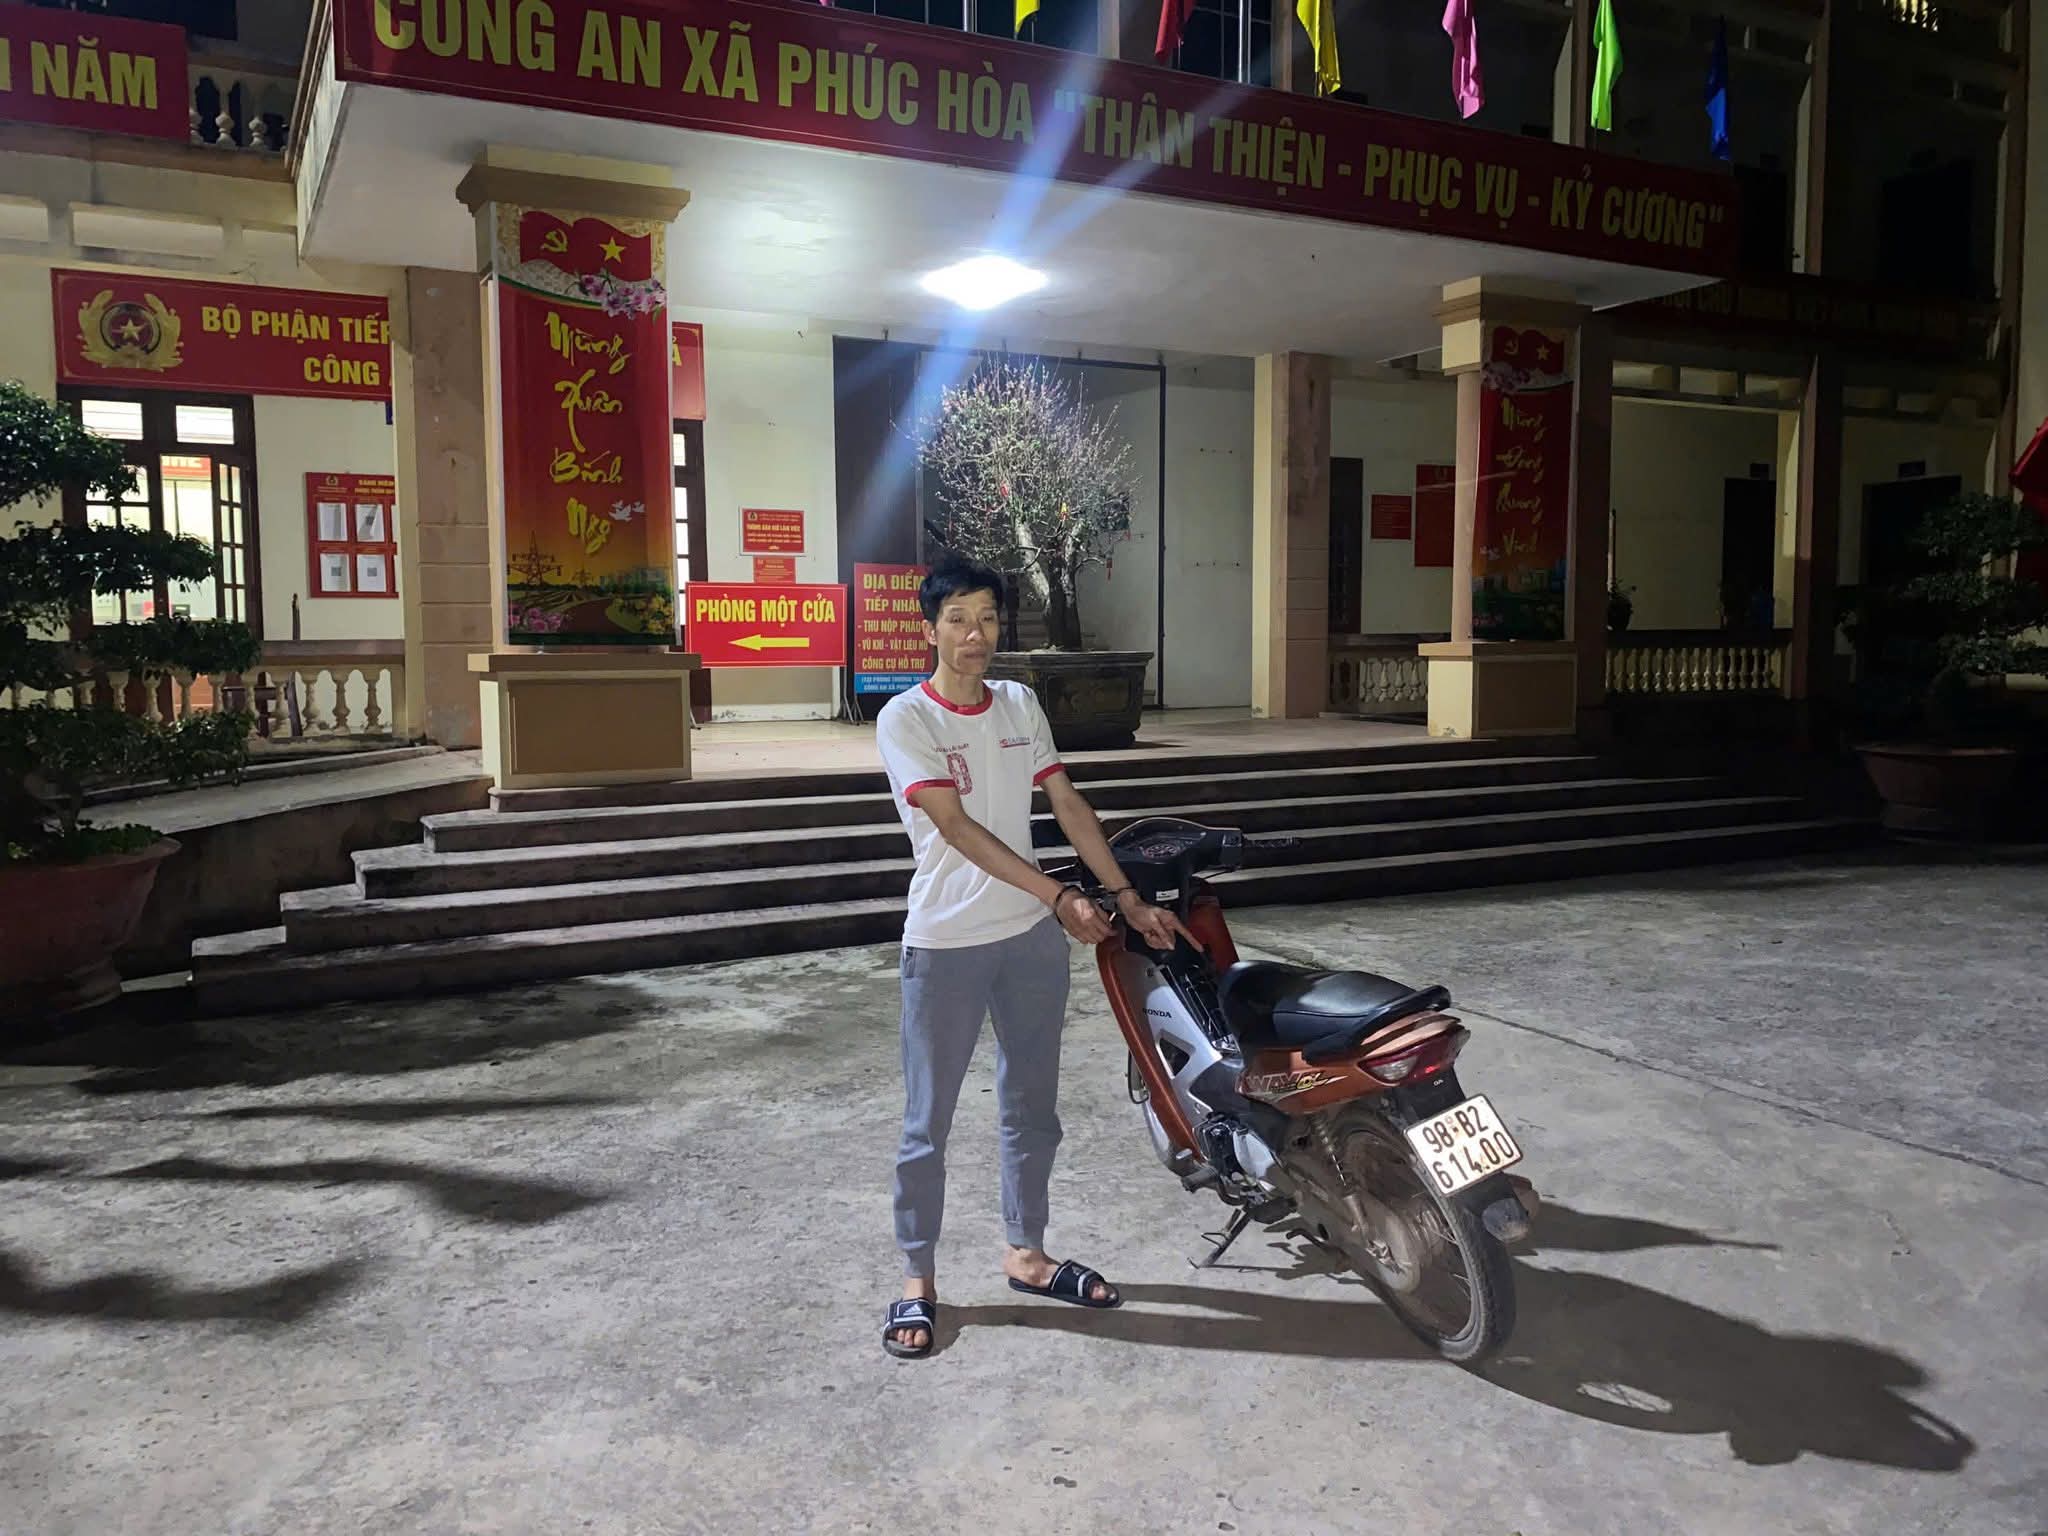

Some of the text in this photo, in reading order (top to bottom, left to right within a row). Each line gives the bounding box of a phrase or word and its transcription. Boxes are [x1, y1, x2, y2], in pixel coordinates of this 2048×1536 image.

[31, 35, 157, 109] NĂM
[577, 9, 661, 88] AN
[682, 21, 759, 102] XÃ
[778, 43, 919, 126] PHÚC
[937, 61, 1034, 144] HÒA
[1209, 117, 1325, 196] THIỆN
[1364, 143, 1462, 216] PHỤC
[1475, 160, 1518, 228] VỤ
[1551, 163, 1593, 230] KỶ
[202, 303, 241, 339] BỘ
[251, 308, 330, 344] PHẬN
[544, 311, 632, 374] Mừng
[304, 353, 380, 386] CÔNG
[554, 368, 623, 453] Xuân
[550, 447, 622, 483] Bính
[863, 573, 887, 593] ĐỊA
[696, 592, 836, 627] PHÒNG MỘT CỬA
[864, 594, 889, 612] TIẾP
[864, 619, 879, 632] THU
[880, 617, 897, 635] NỘP
[862, 656, 884, 670] CÔNG
[885, 658, 896, 672] CỤ
[1142, 1007, 1172, 1018] HONDA
